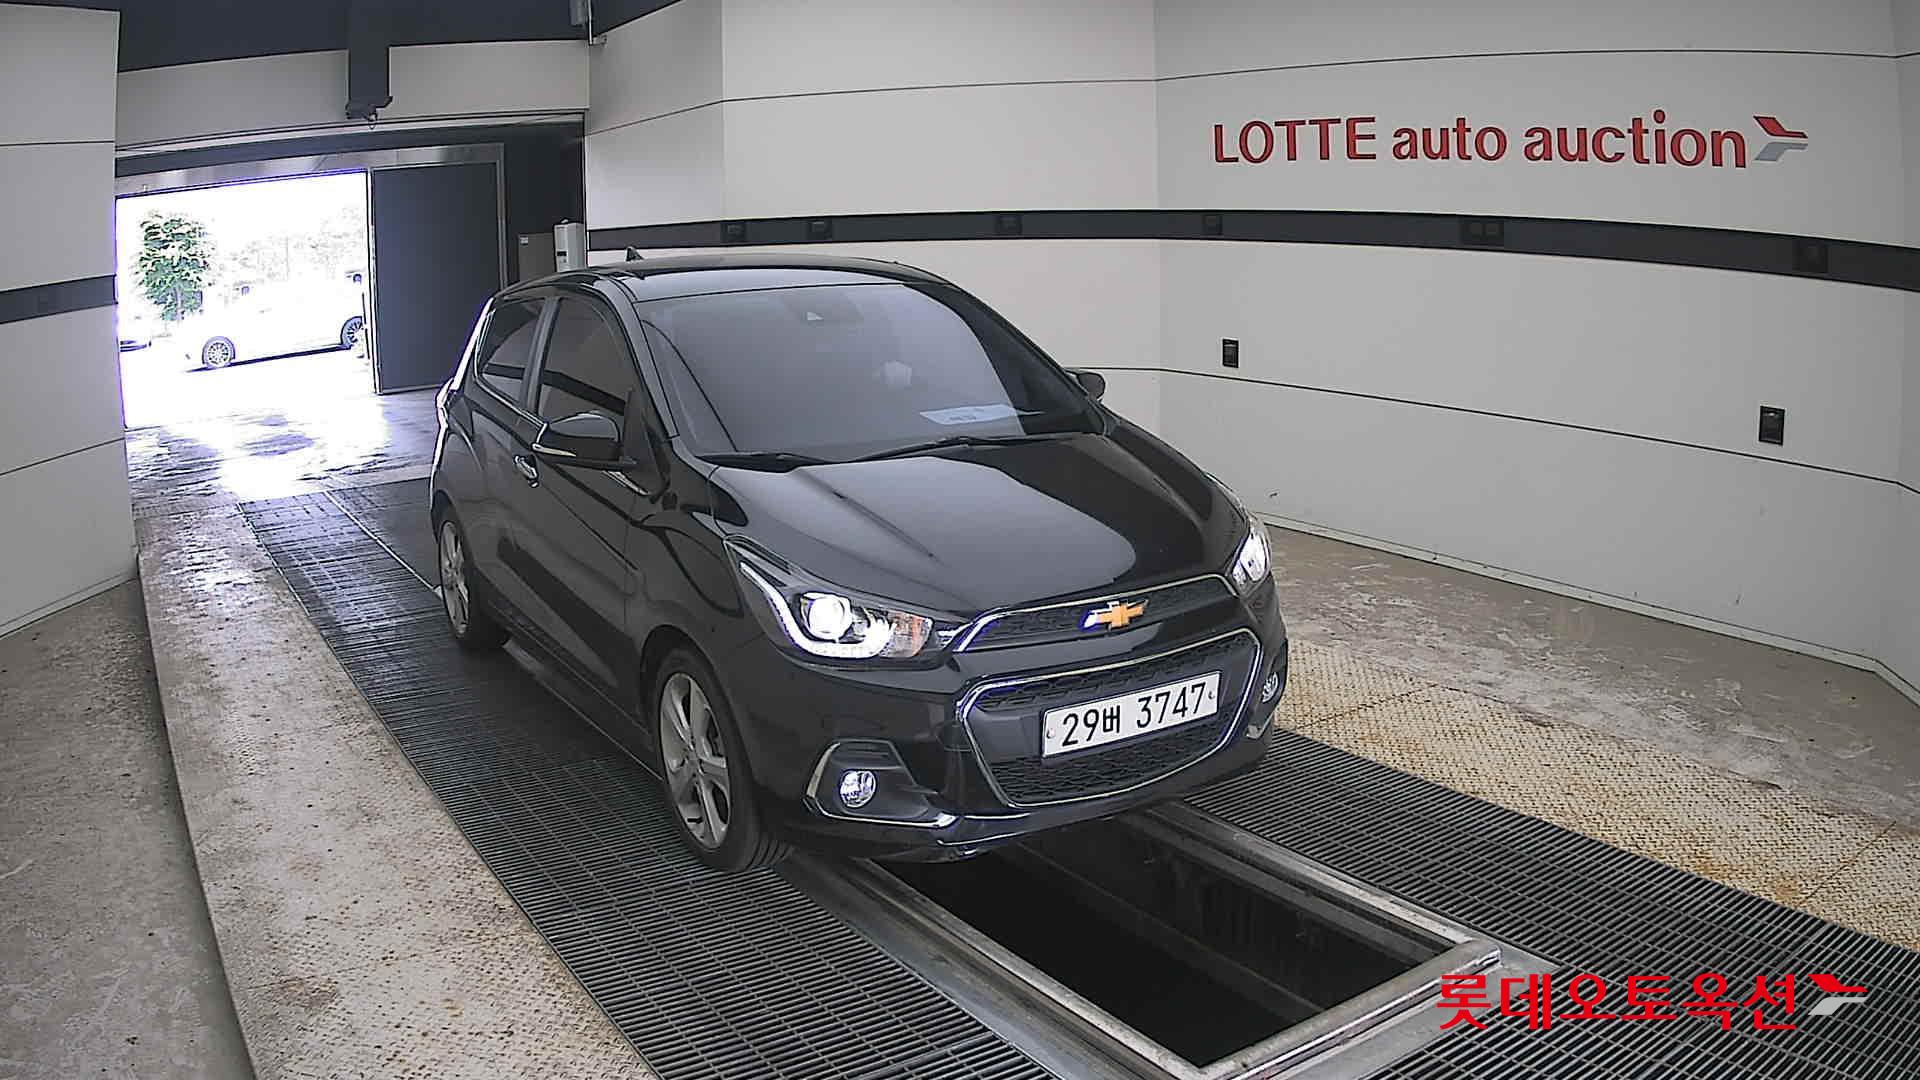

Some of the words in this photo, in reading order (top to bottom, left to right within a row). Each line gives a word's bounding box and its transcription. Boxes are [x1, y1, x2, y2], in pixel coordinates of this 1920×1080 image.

[1213, 116, 1377, 163] LOTTE
[1392, 117, 1507, 161] auto
[1523, 109, 1747, 168] auction
[1062, 705, 1121, 747] 29버
[1136, 682, 1207, 729] 3747
